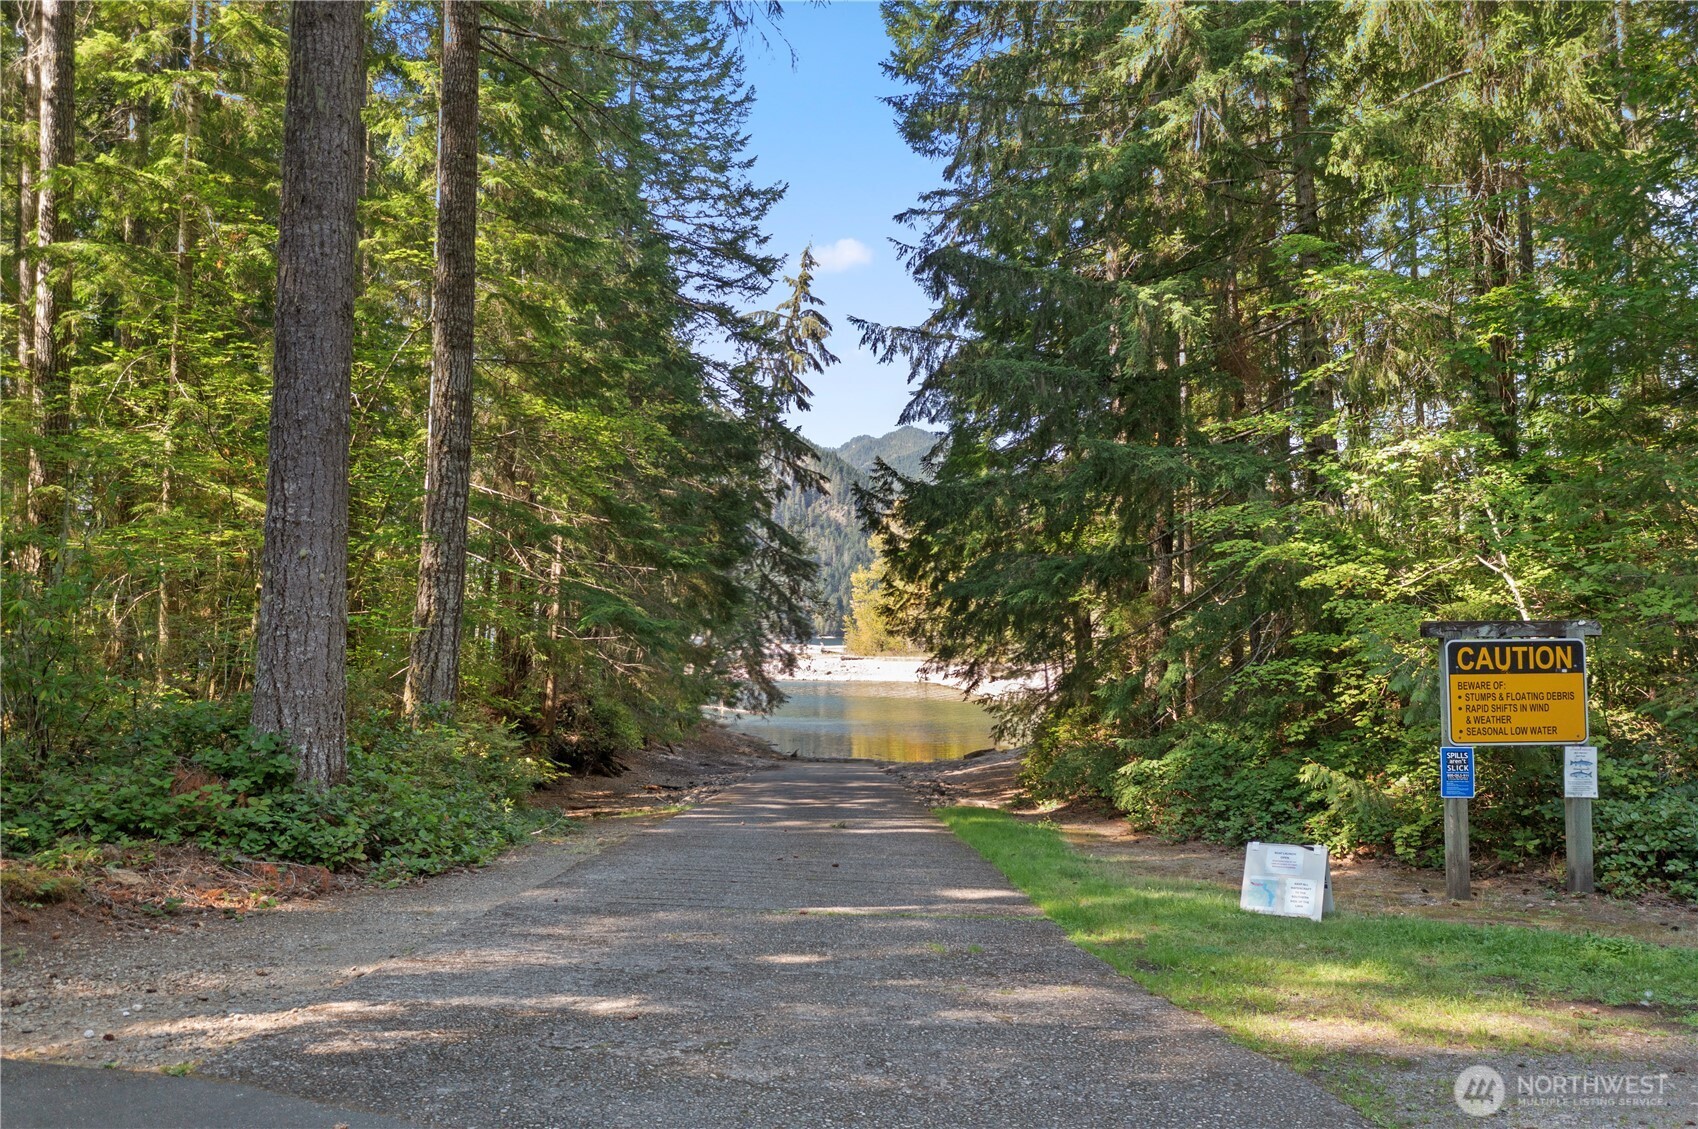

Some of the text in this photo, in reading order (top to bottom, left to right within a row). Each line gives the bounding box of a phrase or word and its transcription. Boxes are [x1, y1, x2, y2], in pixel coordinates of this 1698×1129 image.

[1457, 646, 1572, 670] CAUTION
[1458, 682, 1506, 690] BEWARE OF:
[1465, 693, 1496, 701] STUMPS
[1506, 692, 1544, 700] FLOATING
[1546, 692, 1575, 700] DEBRIS
[1465, 704, 1550, 713] RAPID SHIFTS IN WIND
[1466, 716, 1512, 724] & WEATHER
[1466, 726, 1558, 736] SEASONAL LOW WATER
